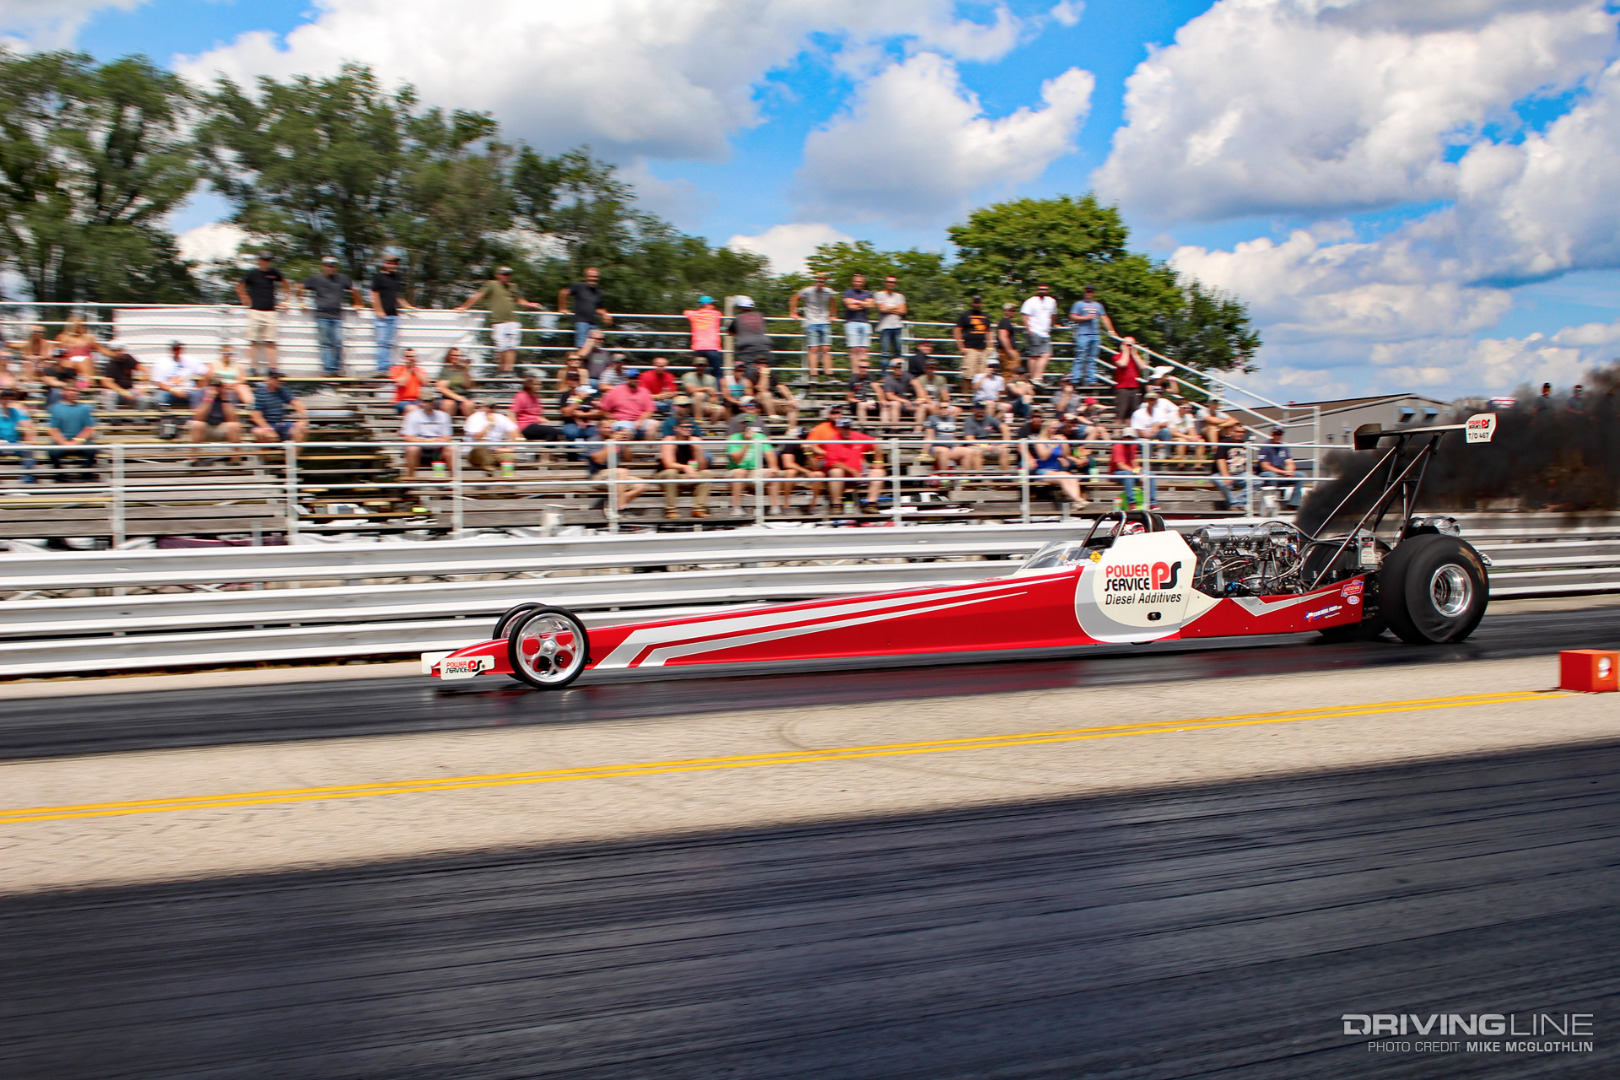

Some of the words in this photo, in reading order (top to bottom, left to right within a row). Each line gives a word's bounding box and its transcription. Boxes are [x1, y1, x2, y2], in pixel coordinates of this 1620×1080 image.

[1105, 563, 1149, 578] POWER
[1151, 561, 1182, 590] PS
[1104, 577, 1150, 592] SERVICE
[1105, 593, 1136, 605] Diesel
[1138, 591, 1182, 604] Additives
